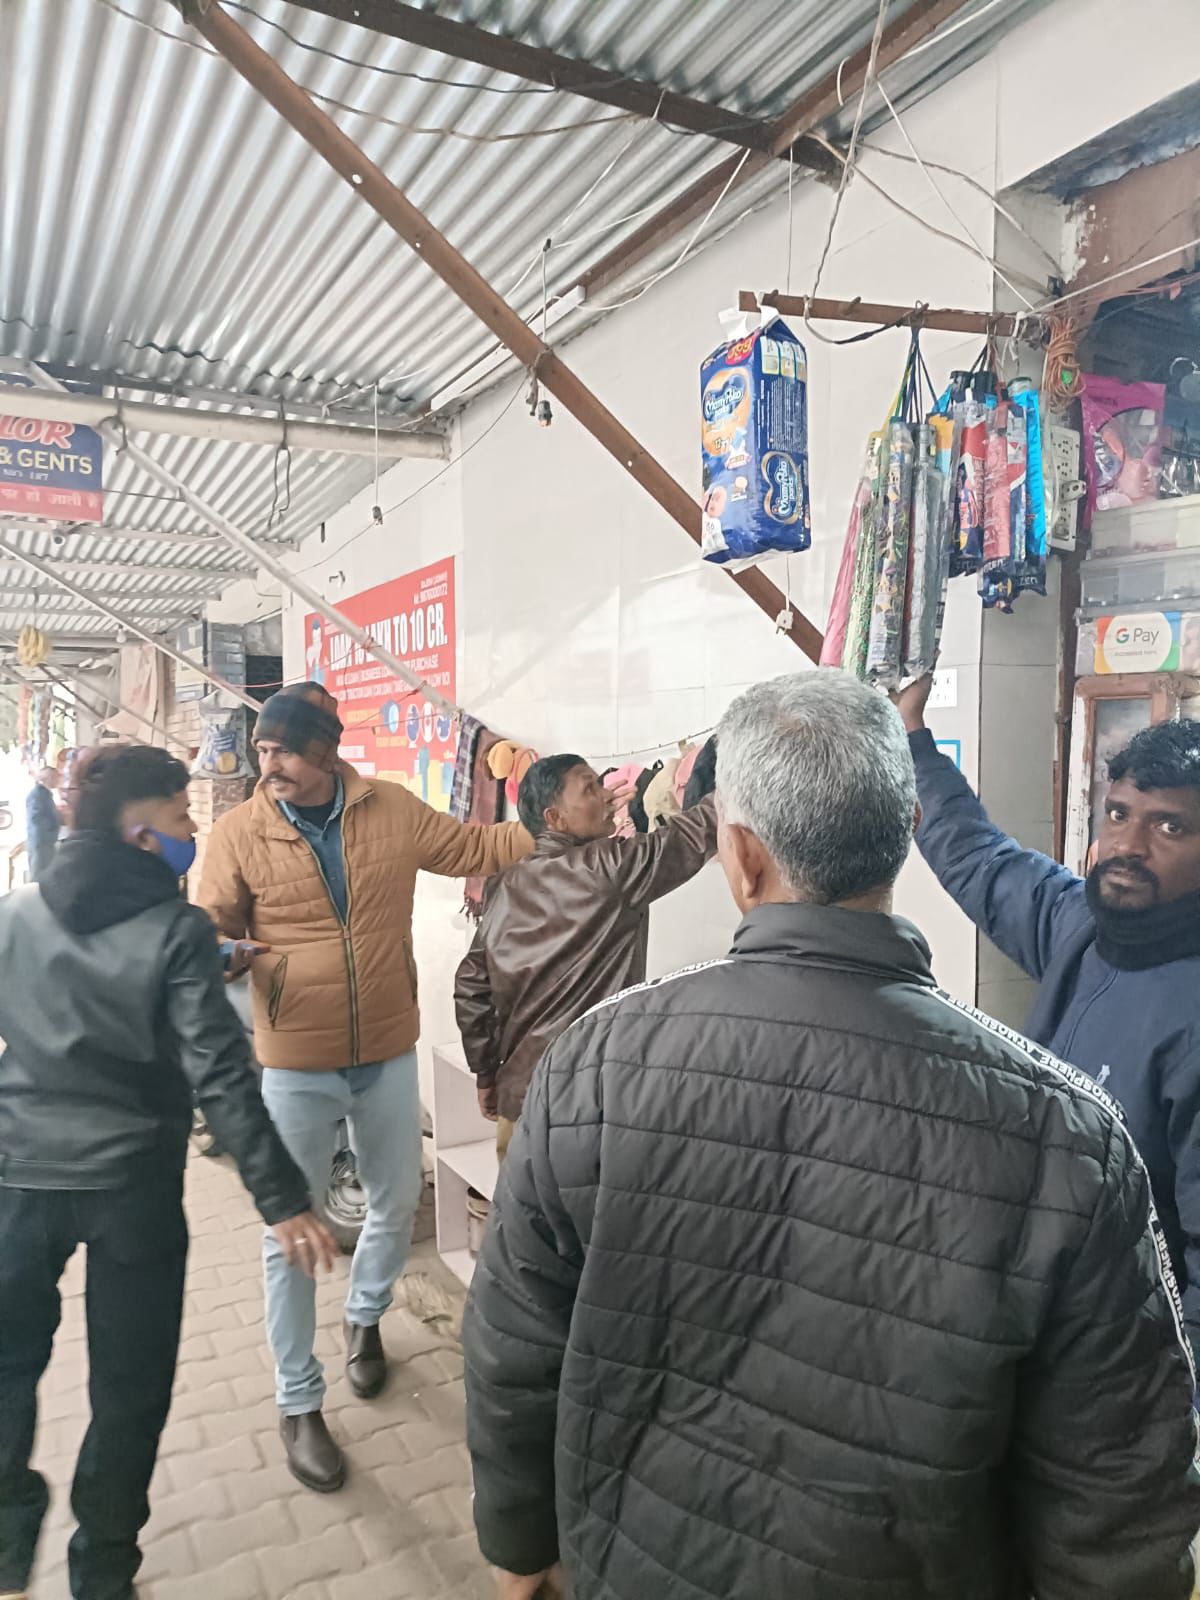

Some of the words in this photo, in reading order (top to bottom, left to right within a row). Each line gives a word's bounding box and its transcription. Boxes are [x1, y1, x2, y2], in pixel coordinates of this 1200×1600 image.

[17, 448, 93, 475] GENTS
[393, 612, 409, 656] TO
[410, 607, 425, 652] 10
[427, 602, 448, 648] CR.
[1133, 628, 1160, 645] Pay
